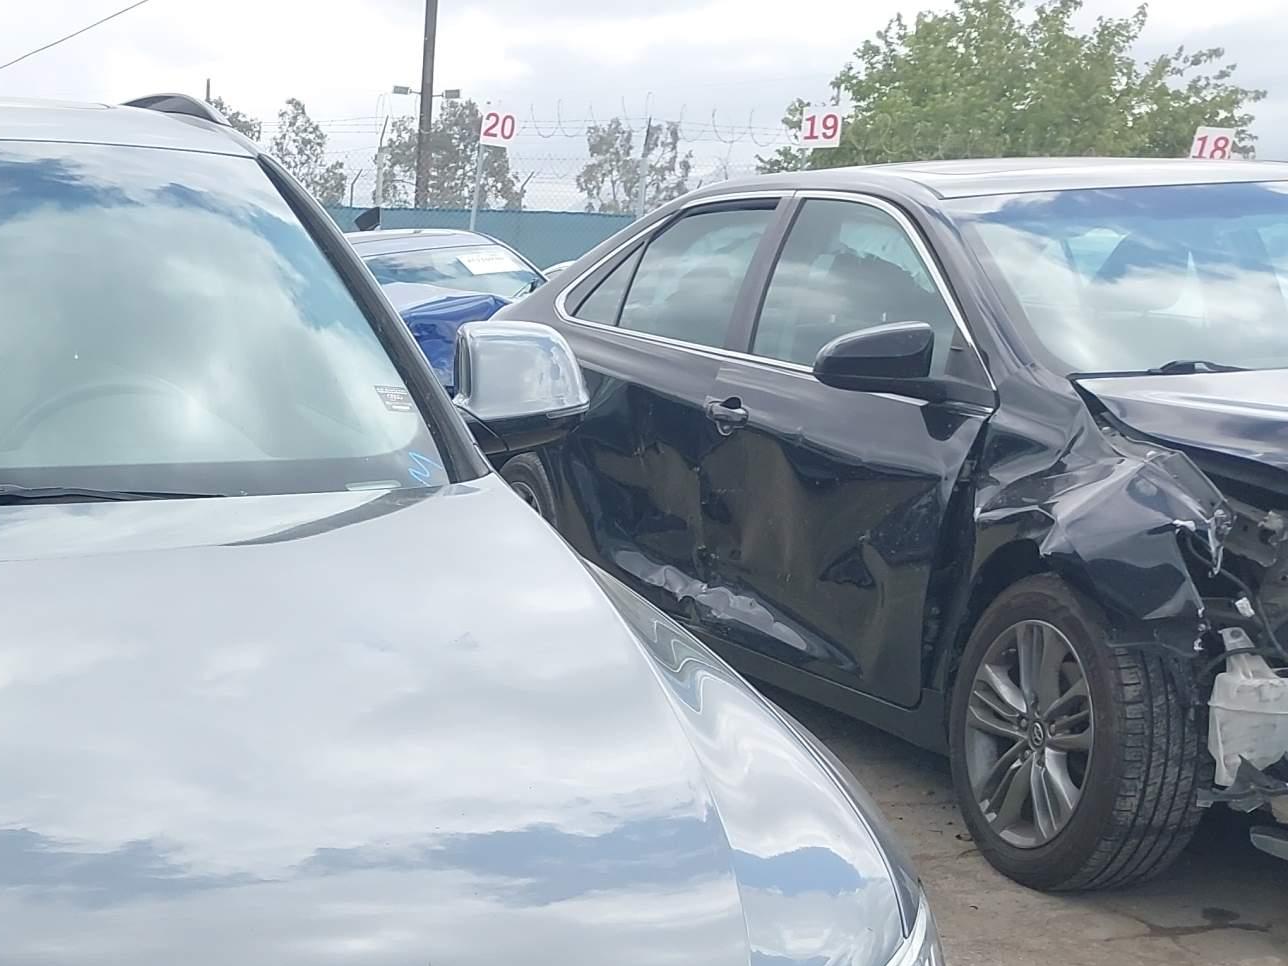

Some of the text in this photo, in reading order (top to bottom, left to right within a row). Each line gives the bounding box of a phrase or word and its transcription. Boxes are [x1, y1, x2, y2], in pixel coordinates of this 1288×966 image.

[482, 112, 516, 140] 20
[803, 113, 839, 140] 19
[1191, 135, 1230, 159] 18
